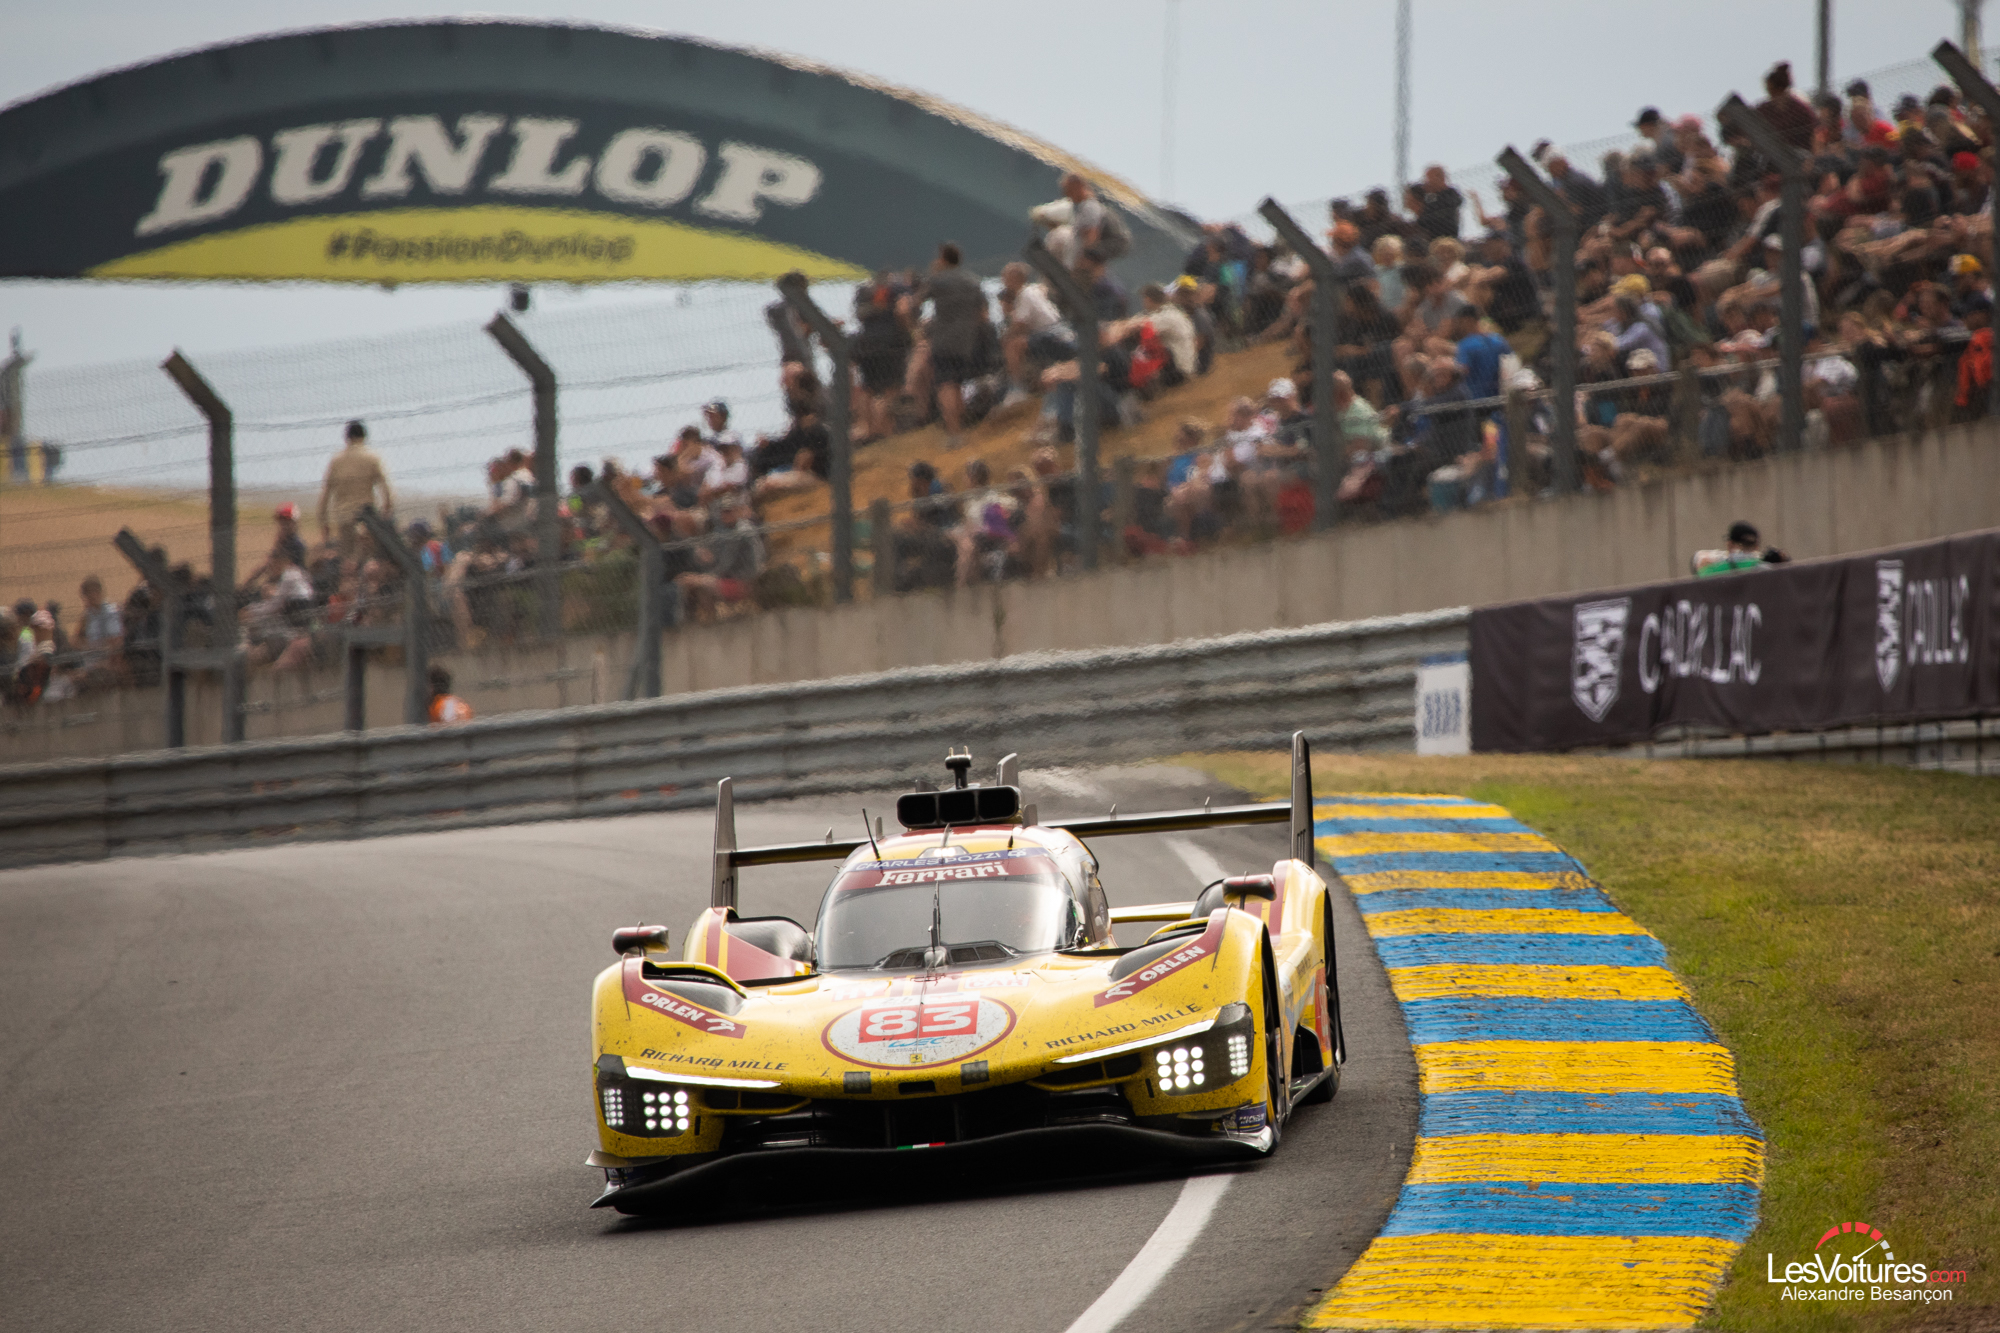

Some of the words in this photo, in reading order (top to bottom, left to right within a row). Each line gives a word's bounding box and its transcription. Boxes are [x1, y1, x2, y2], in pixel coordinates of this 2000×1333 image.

[134, 113, 822, 237] DUNLOP
[856, 857, 940, 870] CHARLES
[944, 852, 1001, 864] POZZI
[875, 861, 1009, 887] Ferrari
[1139, 945, 1206, 982] ORLEN
[641, 993, 705, 1022] ORLEN
[865, 1005, 972, 1036] 83
[1044, 1023, 1137, 1049] RICHARD
[1140, 1002, 1203, 1026] MILLE
[639, 1048, 724, 1068] RICHARD
[725, 1059, 789, 1070] MILLE
